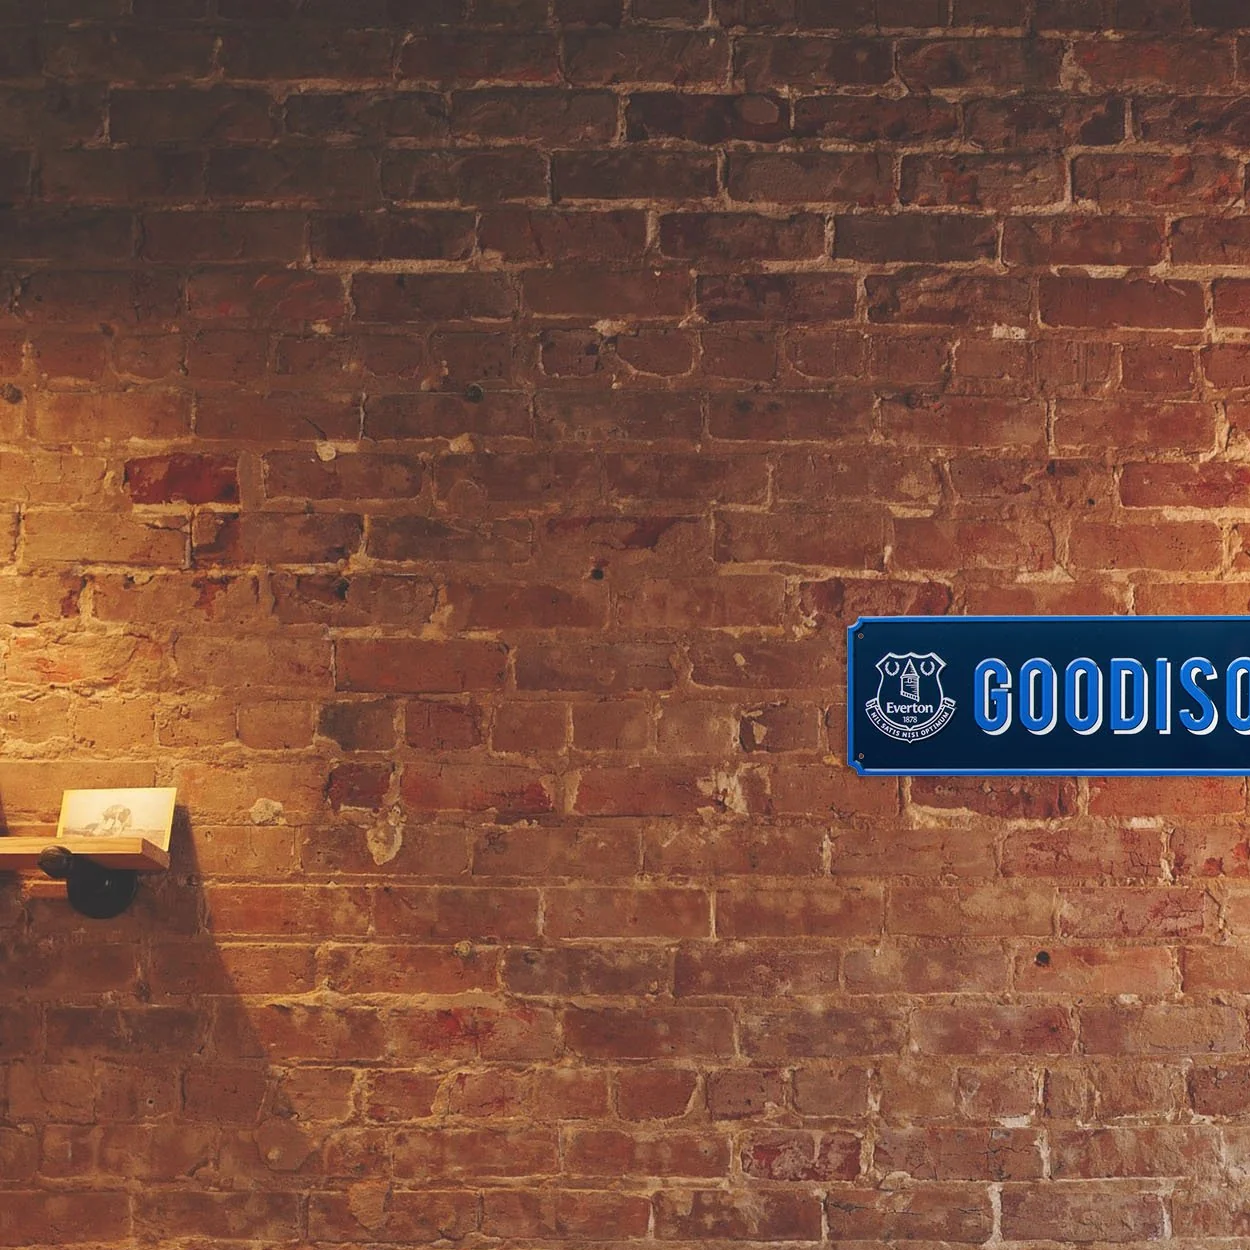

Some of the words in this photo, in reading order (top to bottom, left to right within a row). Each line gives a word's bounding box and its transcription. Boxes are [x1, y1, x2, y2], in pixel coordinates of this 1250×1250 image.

[886, 702, 934, 714] Everton
[870, 712, 880, 725] NIL
[881, 723, 900, 737] SATIS
[920, 711, 950, 735] OPTIMUM
